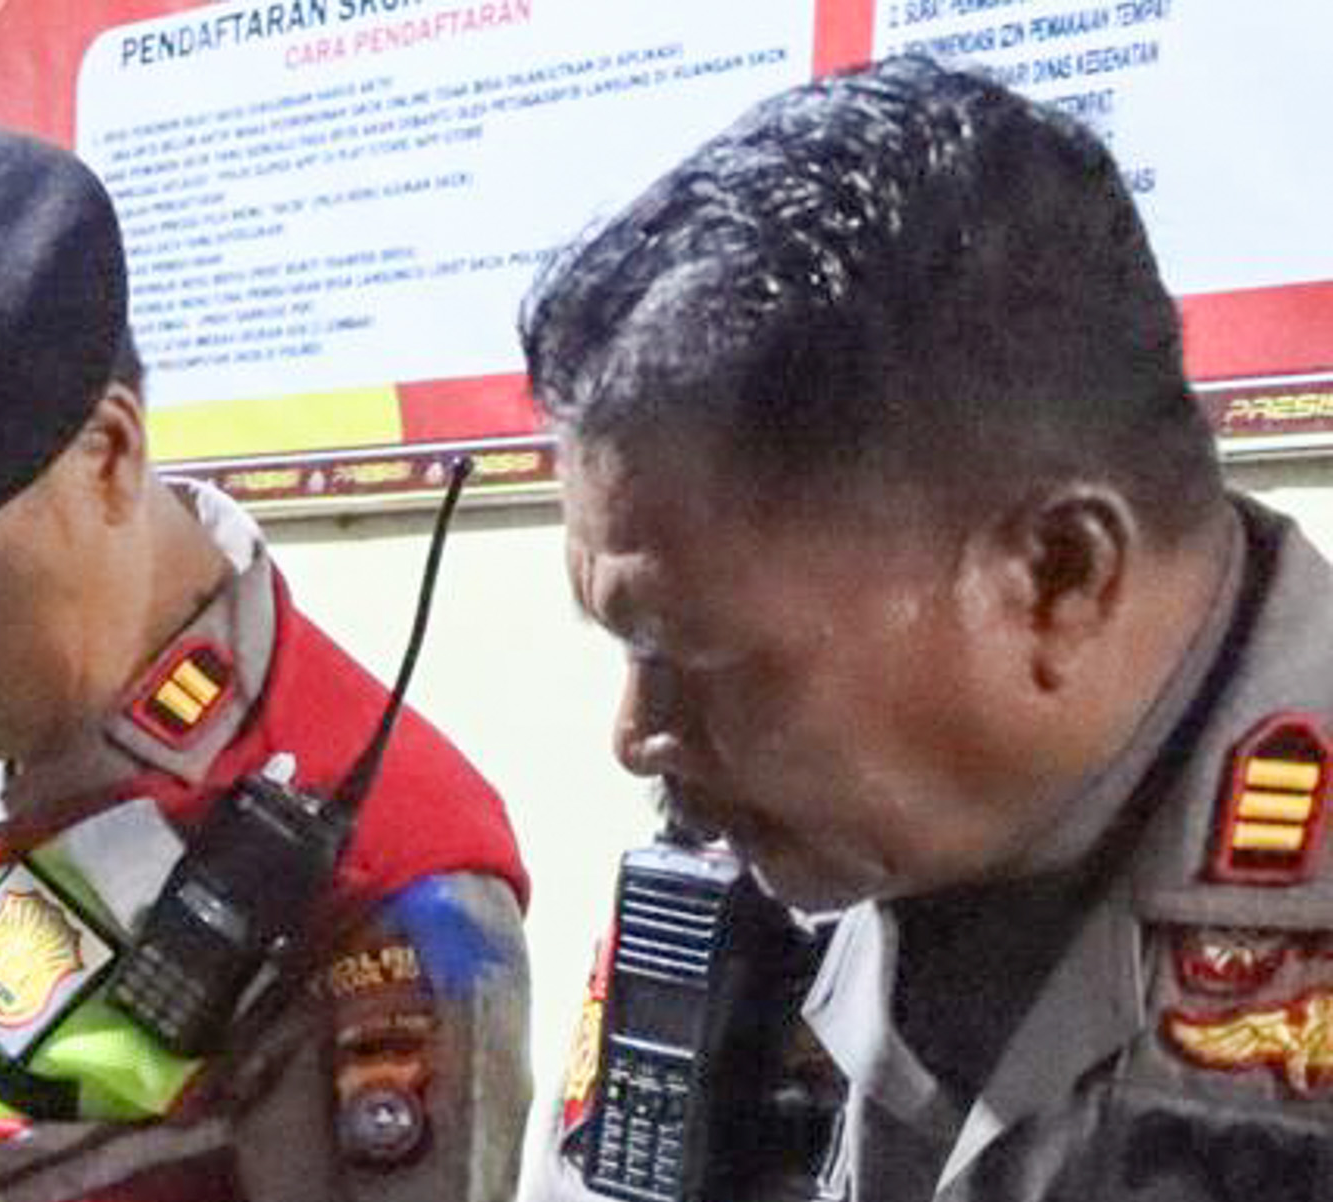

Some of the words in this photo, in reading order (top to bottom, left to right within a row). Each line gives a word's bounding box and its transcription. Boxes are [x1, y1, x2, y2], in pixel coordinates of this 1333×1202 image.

[120, 0, 327, 67] PENDAFTARAN
[284, 32, 346, 69] CARA
[353, 0, 532, 57] PENDAFTARAN
